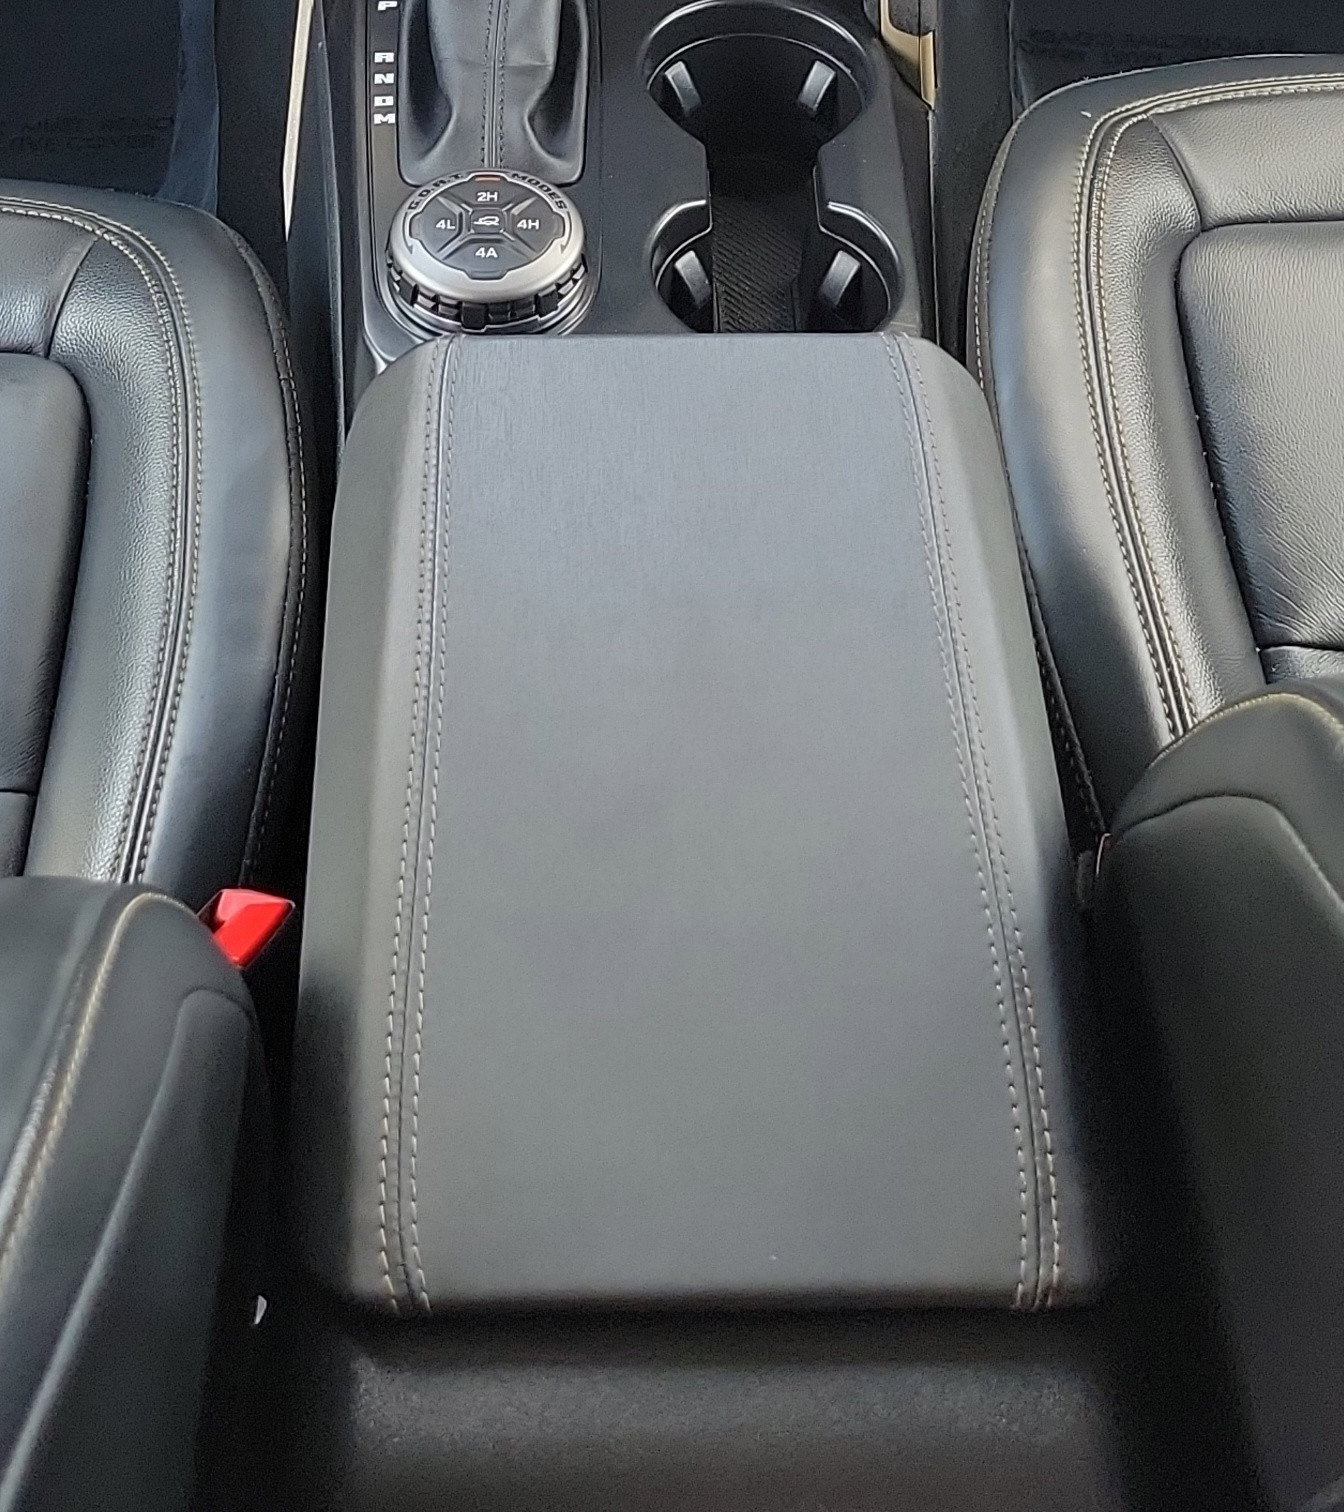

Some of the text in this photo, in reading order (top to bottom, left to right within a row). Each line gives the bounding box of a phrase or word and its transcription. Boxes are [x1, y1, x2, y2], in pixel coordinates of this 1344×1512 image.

[377, 0, 398, 11] P
[374, 52, 395, 63] R
[374, 73, 395, 84] N
[373, 113, 396, 125] M
[477, 191, 499, 202] 2H
[512, 173, 568, 210] MODES
[435, 219, 456, 229] 4L
[516, 219, 540, 230] 4H
[475, 247, 498, 258] 4A
